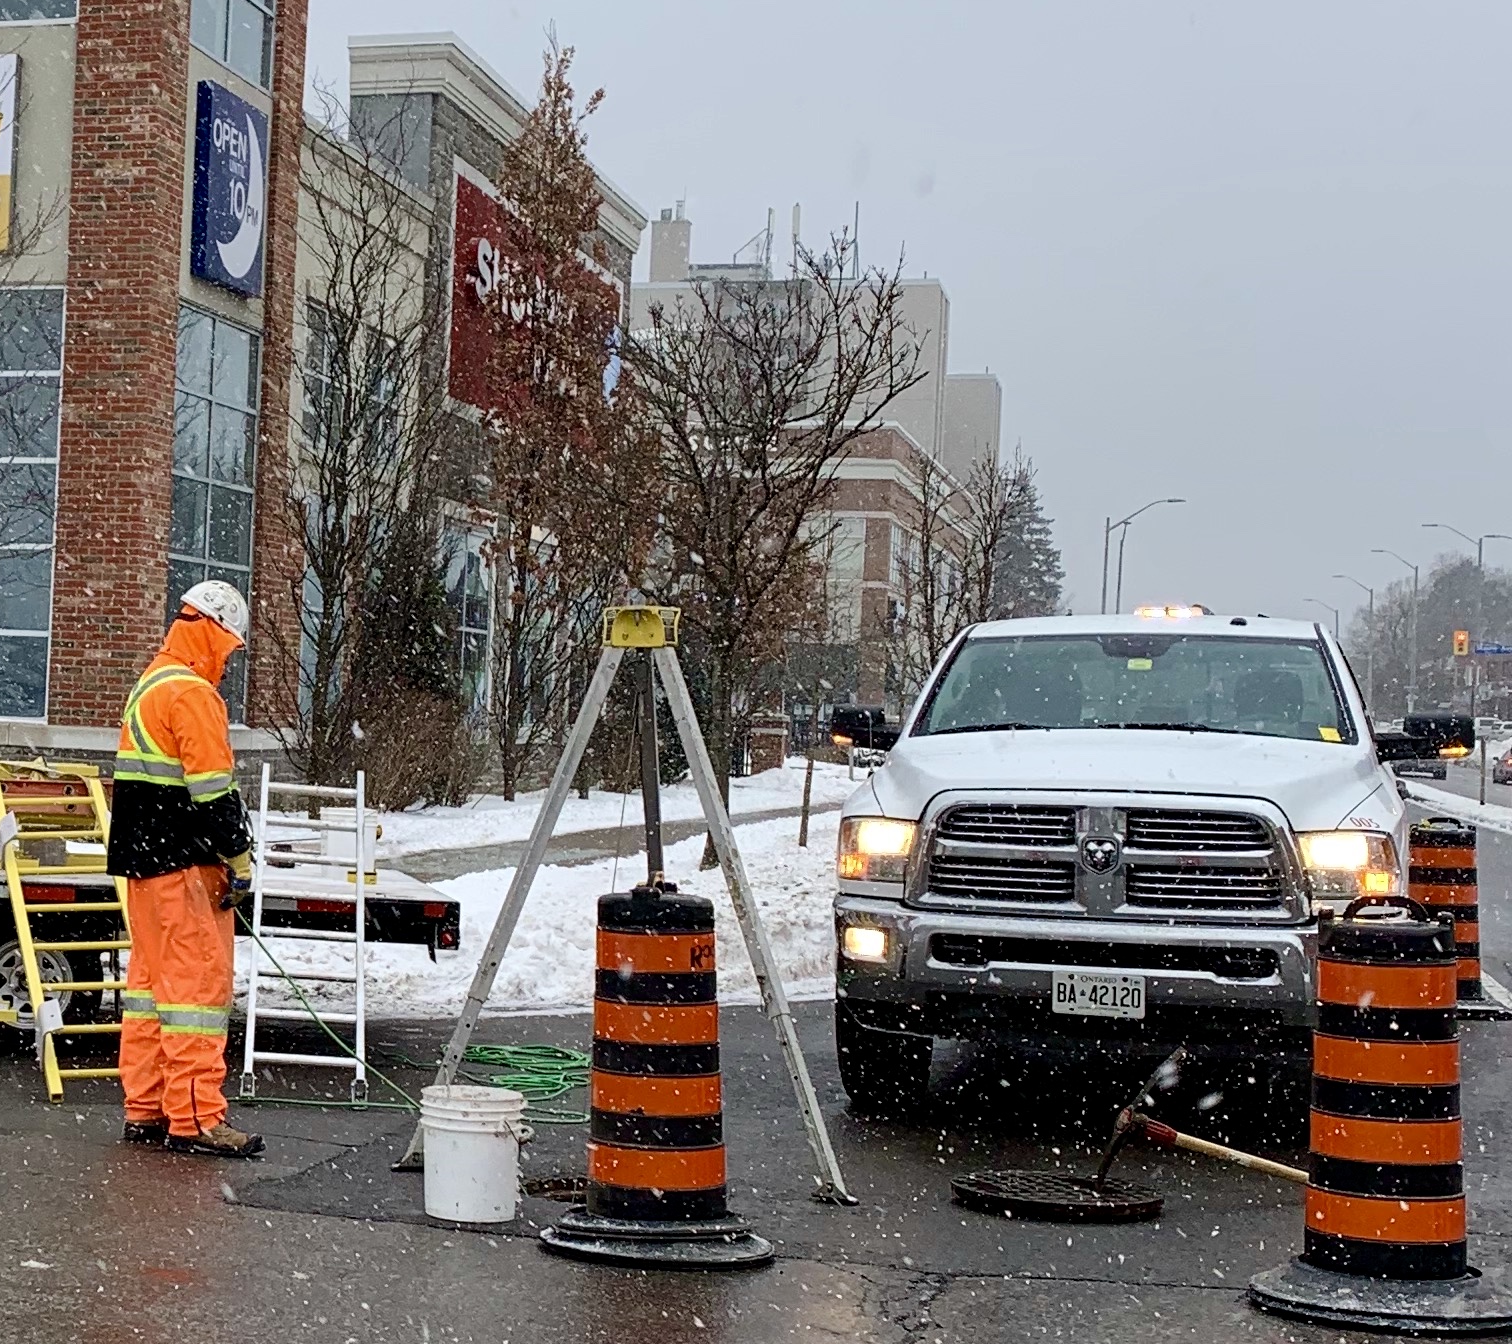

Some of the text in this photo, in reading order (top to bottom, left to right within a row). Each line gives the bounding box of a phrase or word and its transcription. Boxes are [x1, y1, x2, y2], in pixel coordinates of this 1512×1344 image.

[212, 117, 248, 163] OPEN
[229, 177, 259, 227] 10 PM
[1349, 817, 1381, 829] 005
[1080, 975, 1118, 985] ONTARIO
[1057, 982, 1141, 1009] BA 42120
